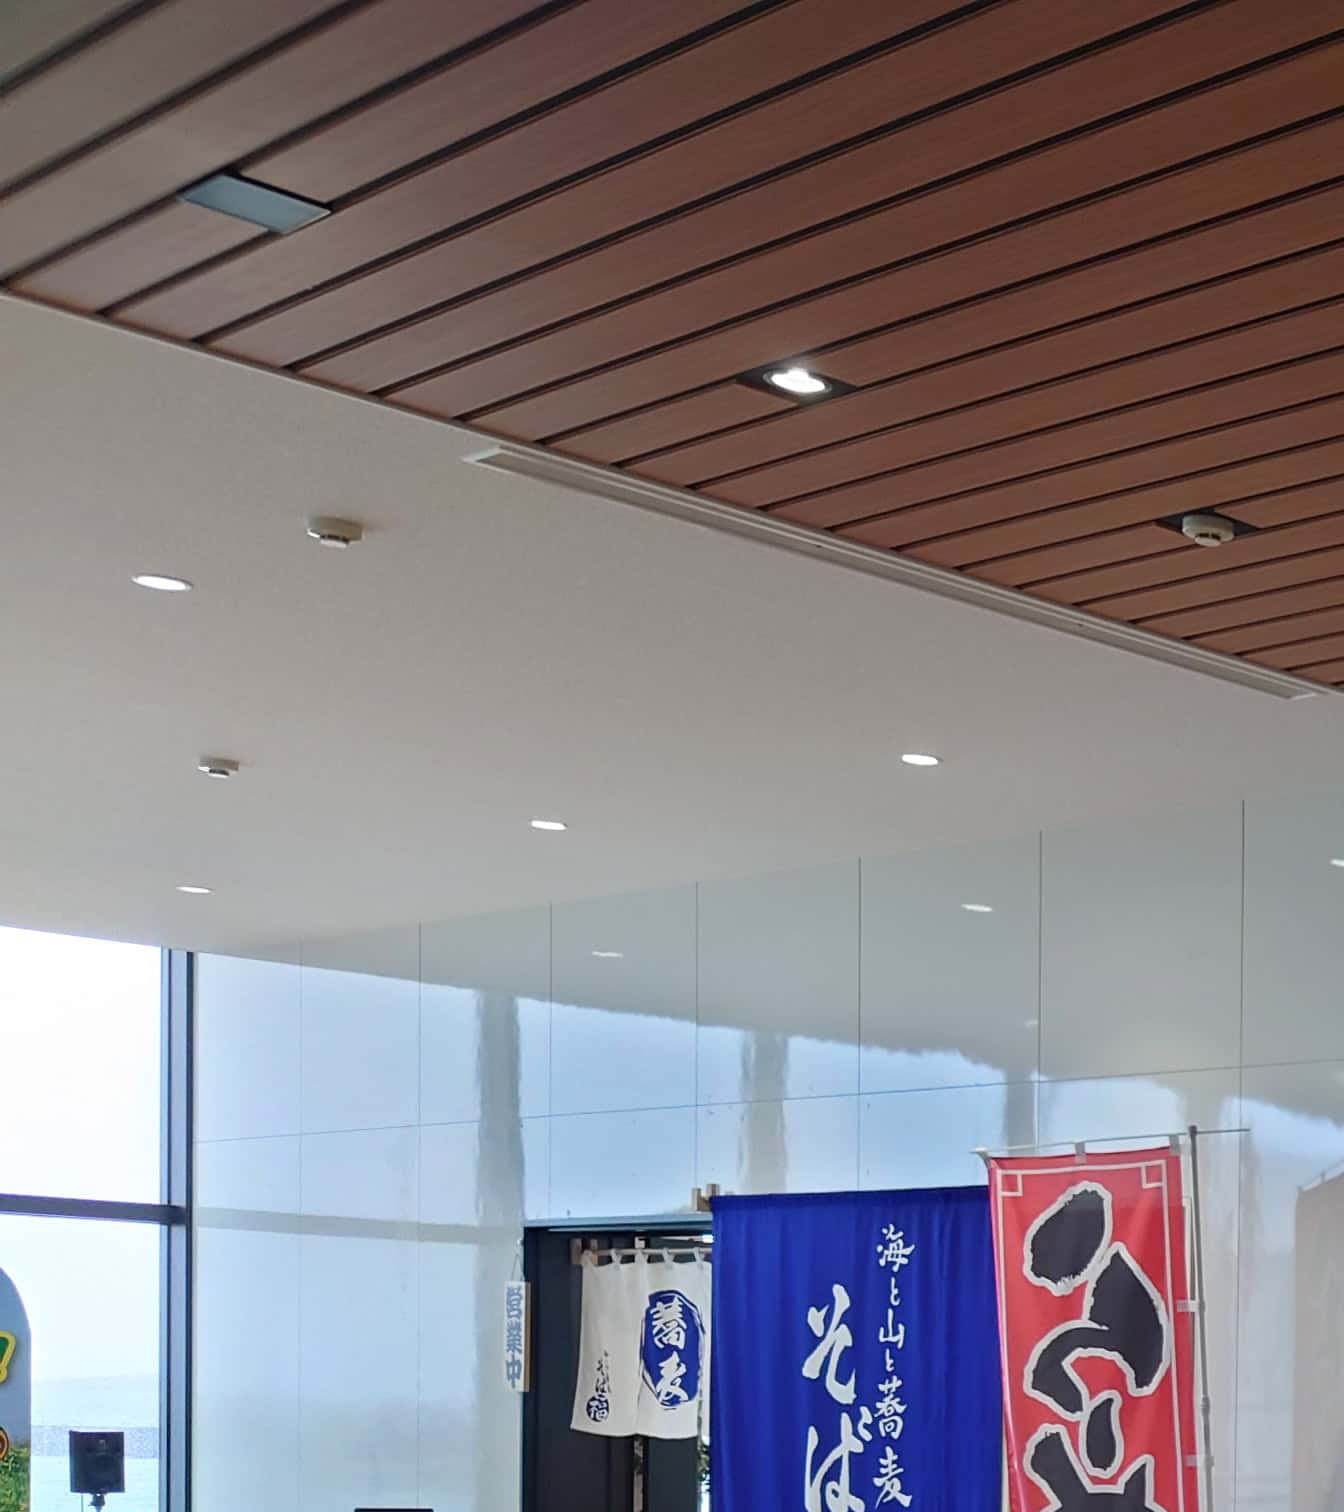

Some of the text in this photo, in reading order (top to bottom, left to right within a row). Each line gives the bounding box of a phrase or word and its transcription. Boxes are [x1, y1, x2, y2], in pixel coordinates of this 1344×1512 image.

[506, 1286, 524, 1388] 営業中
[873, 1224, 914, 1508] 海と山と蕎麦
